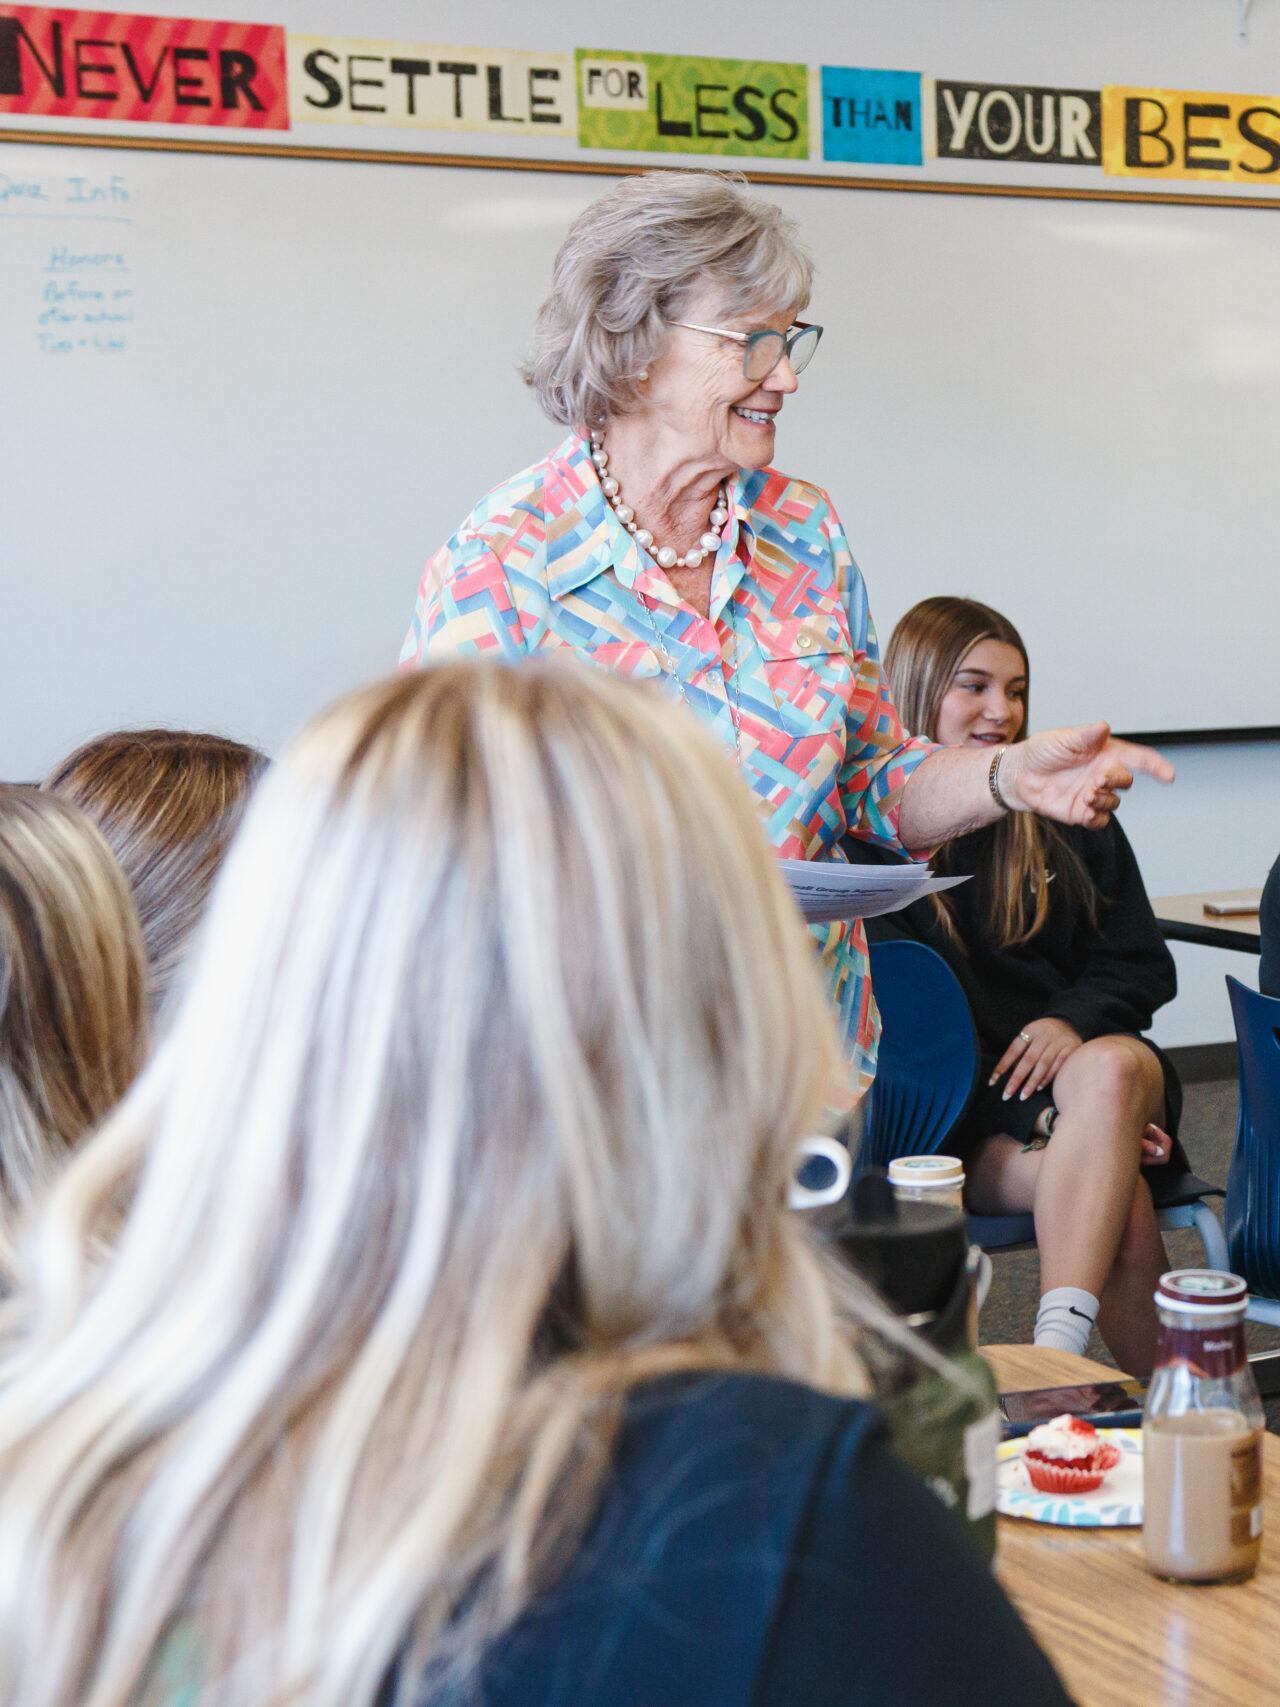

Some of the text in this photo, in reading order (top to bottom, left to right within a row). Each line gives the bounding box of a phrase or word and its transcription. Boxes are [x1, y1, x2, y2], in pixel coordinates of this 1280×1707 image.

[0, 16, 266, 111] NEVER
[303, 48, 563, 124] SETTLE
[587, 68, 643, 99] FOR
[656, 82, 798, 142] LESS
[826, 96, 913, 132] THAN
[941, 89, 1098, 158] YOUR
